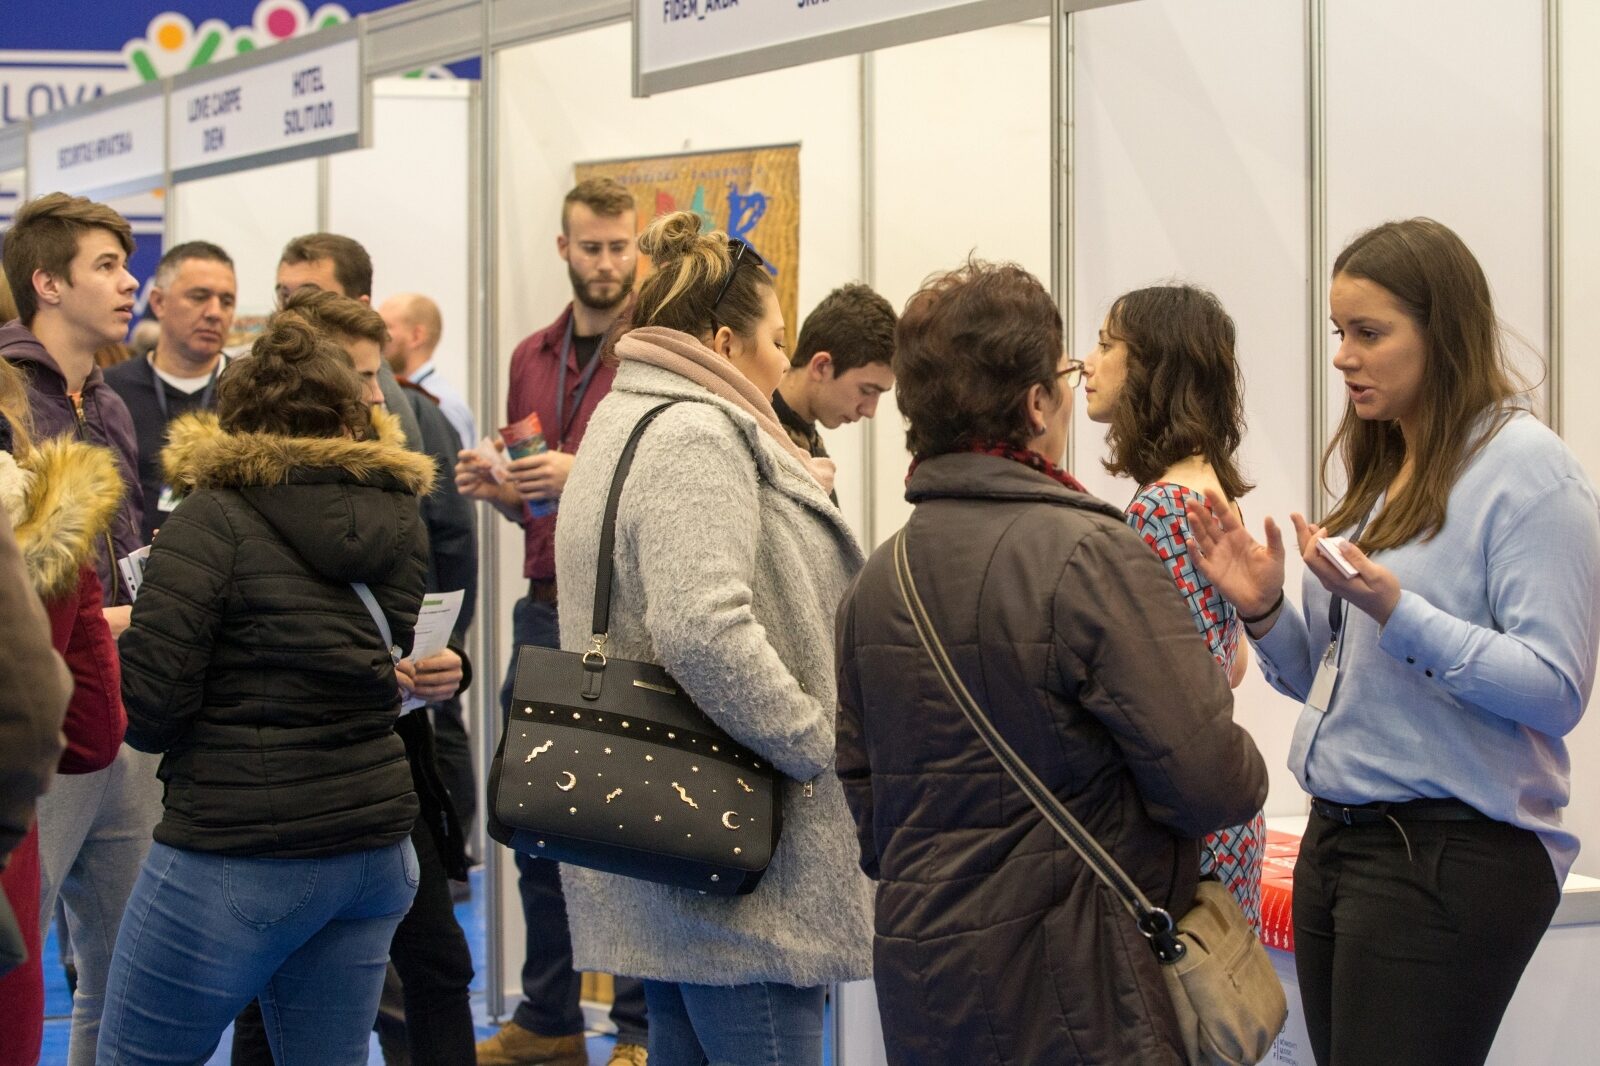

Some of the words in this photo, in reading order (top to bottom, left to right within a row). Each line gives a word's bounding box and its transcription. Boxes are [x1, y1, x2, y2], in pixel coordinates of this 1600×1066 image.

[663, 0, 739, 23] FIDEM_A
[292, 66, 324, 98] HOTEL
[188, 95, 210, 122] LOVE
[212, 87, 242, 116] CARPE
[284, 101, 333, 136] SOLITUDO
